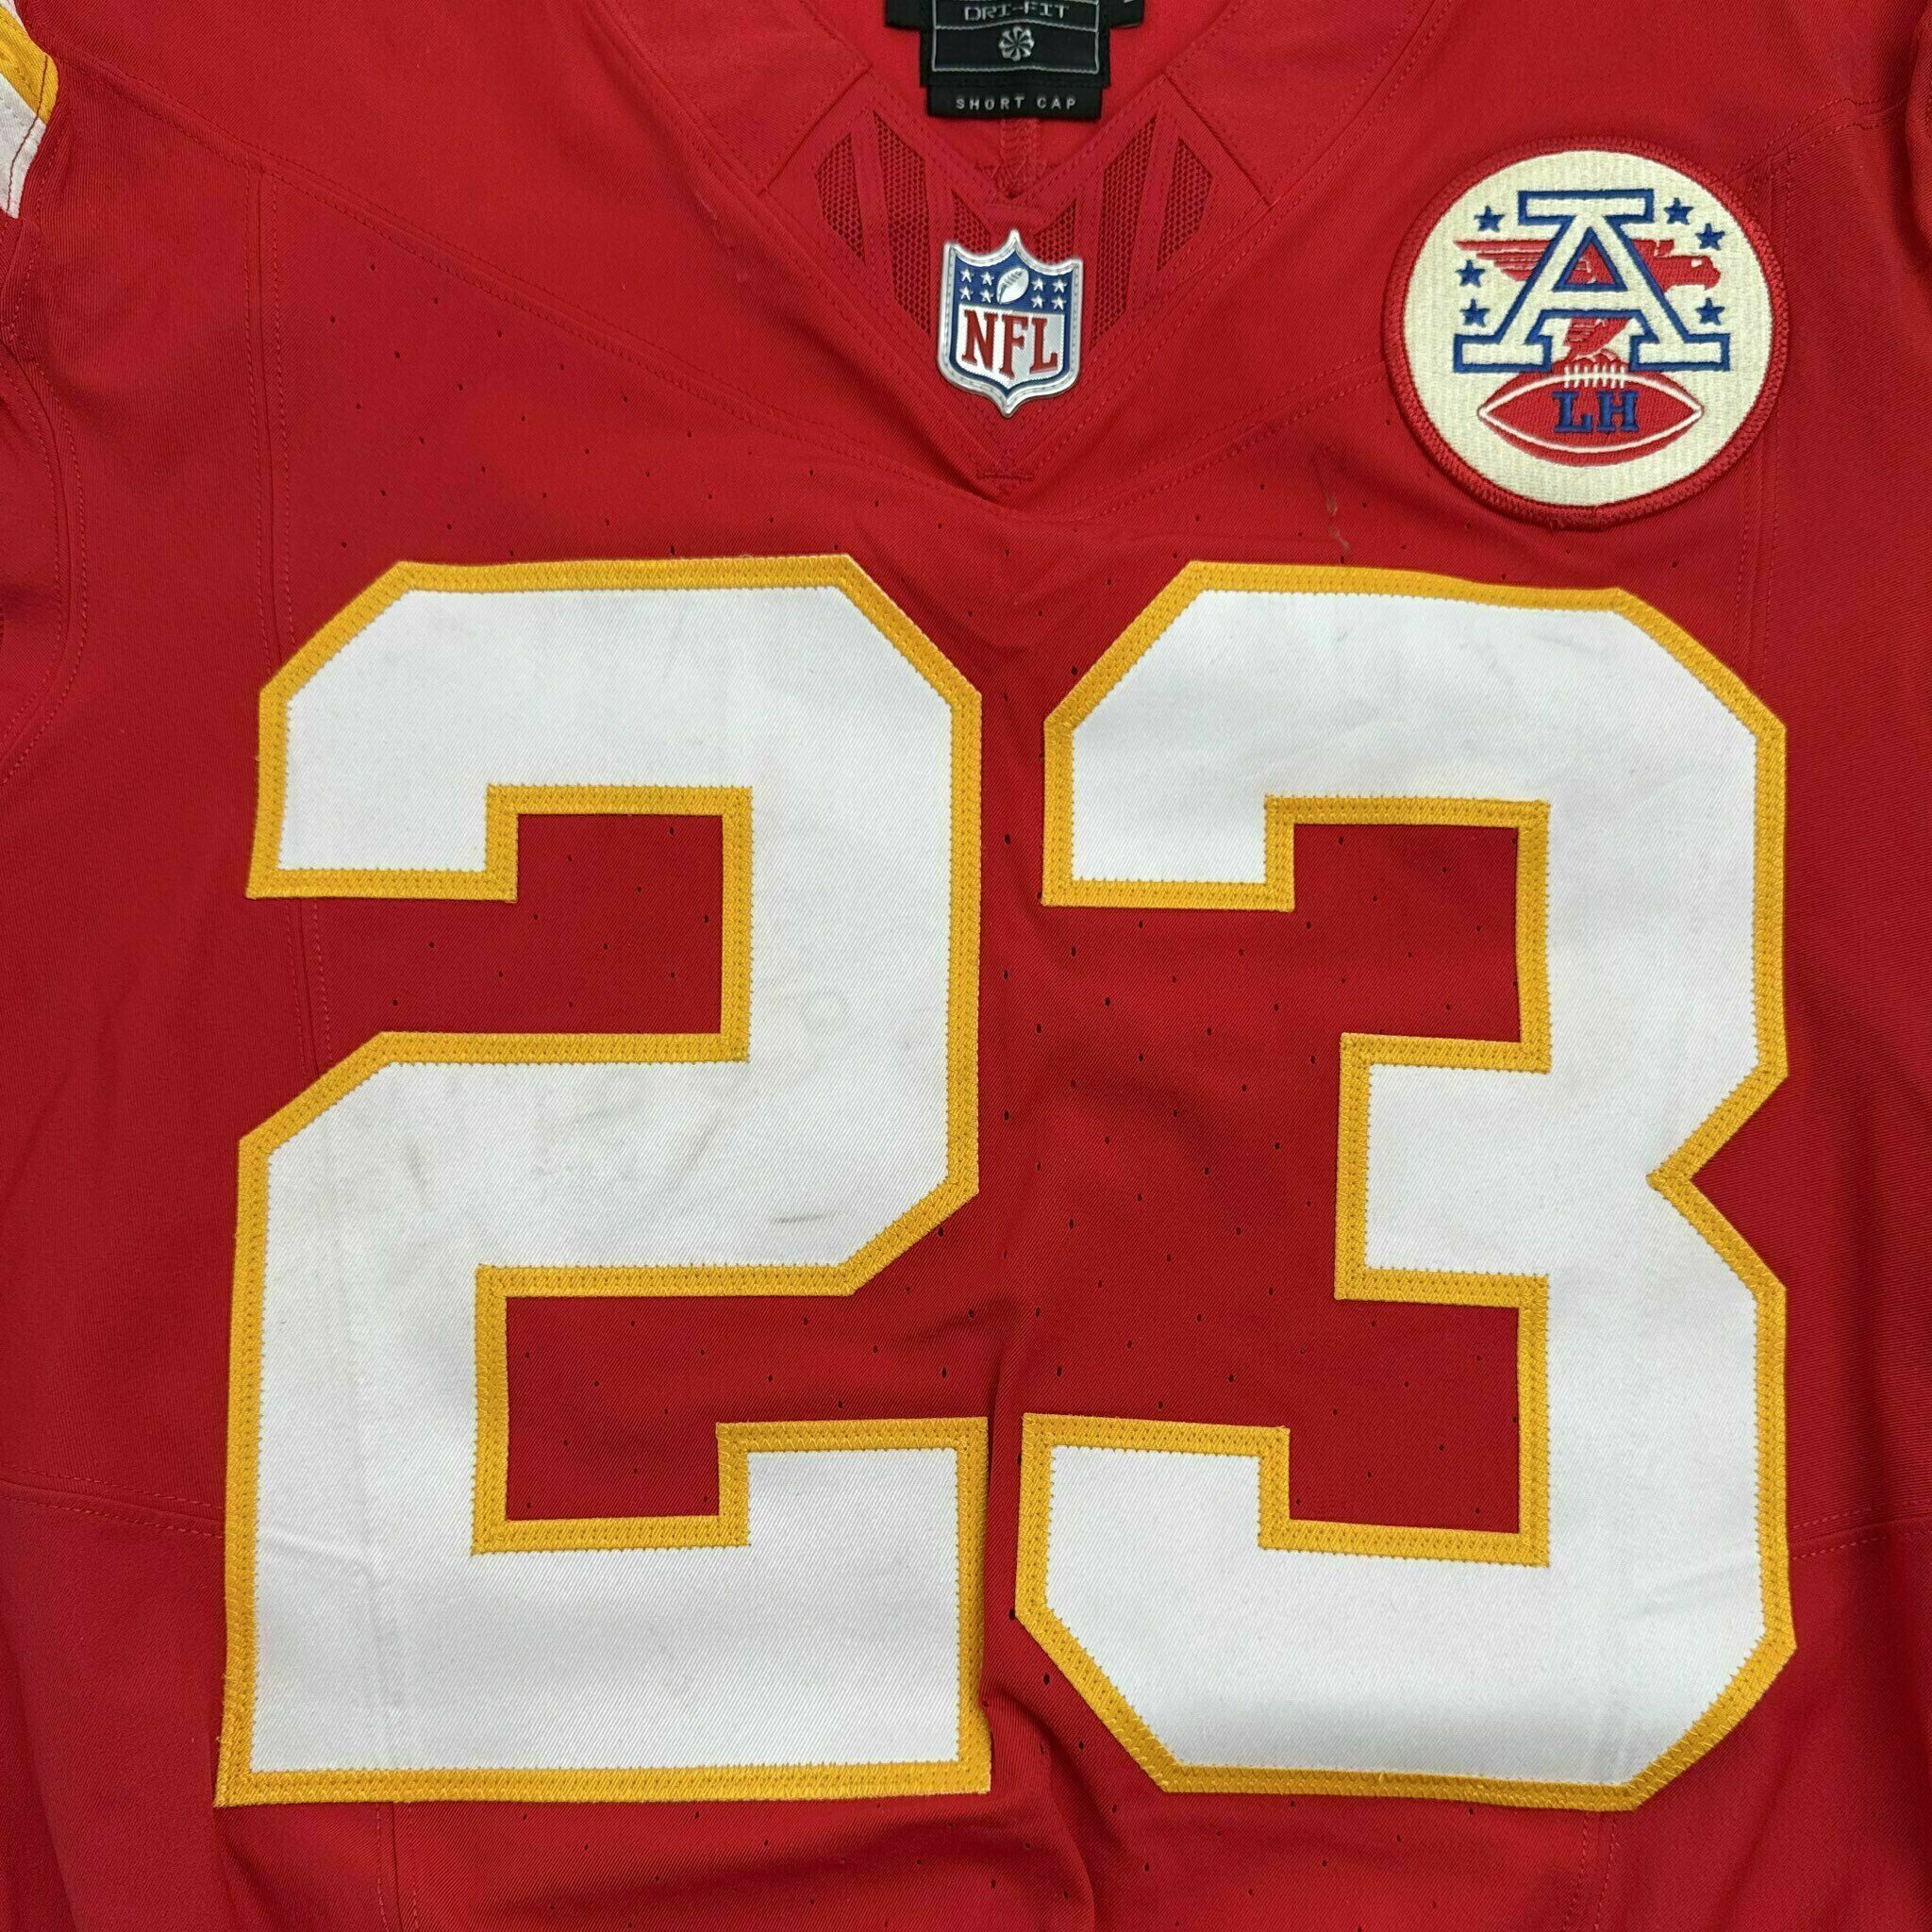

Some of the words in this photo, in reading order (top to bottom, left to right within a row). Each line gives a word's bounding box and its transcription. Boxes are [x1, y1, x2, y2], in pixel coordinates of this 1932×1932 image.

[963, 2, 1069, 22] DRI-FIT
[956, 96, 1025, 111] SHORT
[1037, 96, 1077, 111] CAP
[1453, 188, 1730, 374] A
[961, 308, 1058, 380] NFL
[1552, 390, 1641, 434] LH
[215, 553, 1798, 1811] 23
